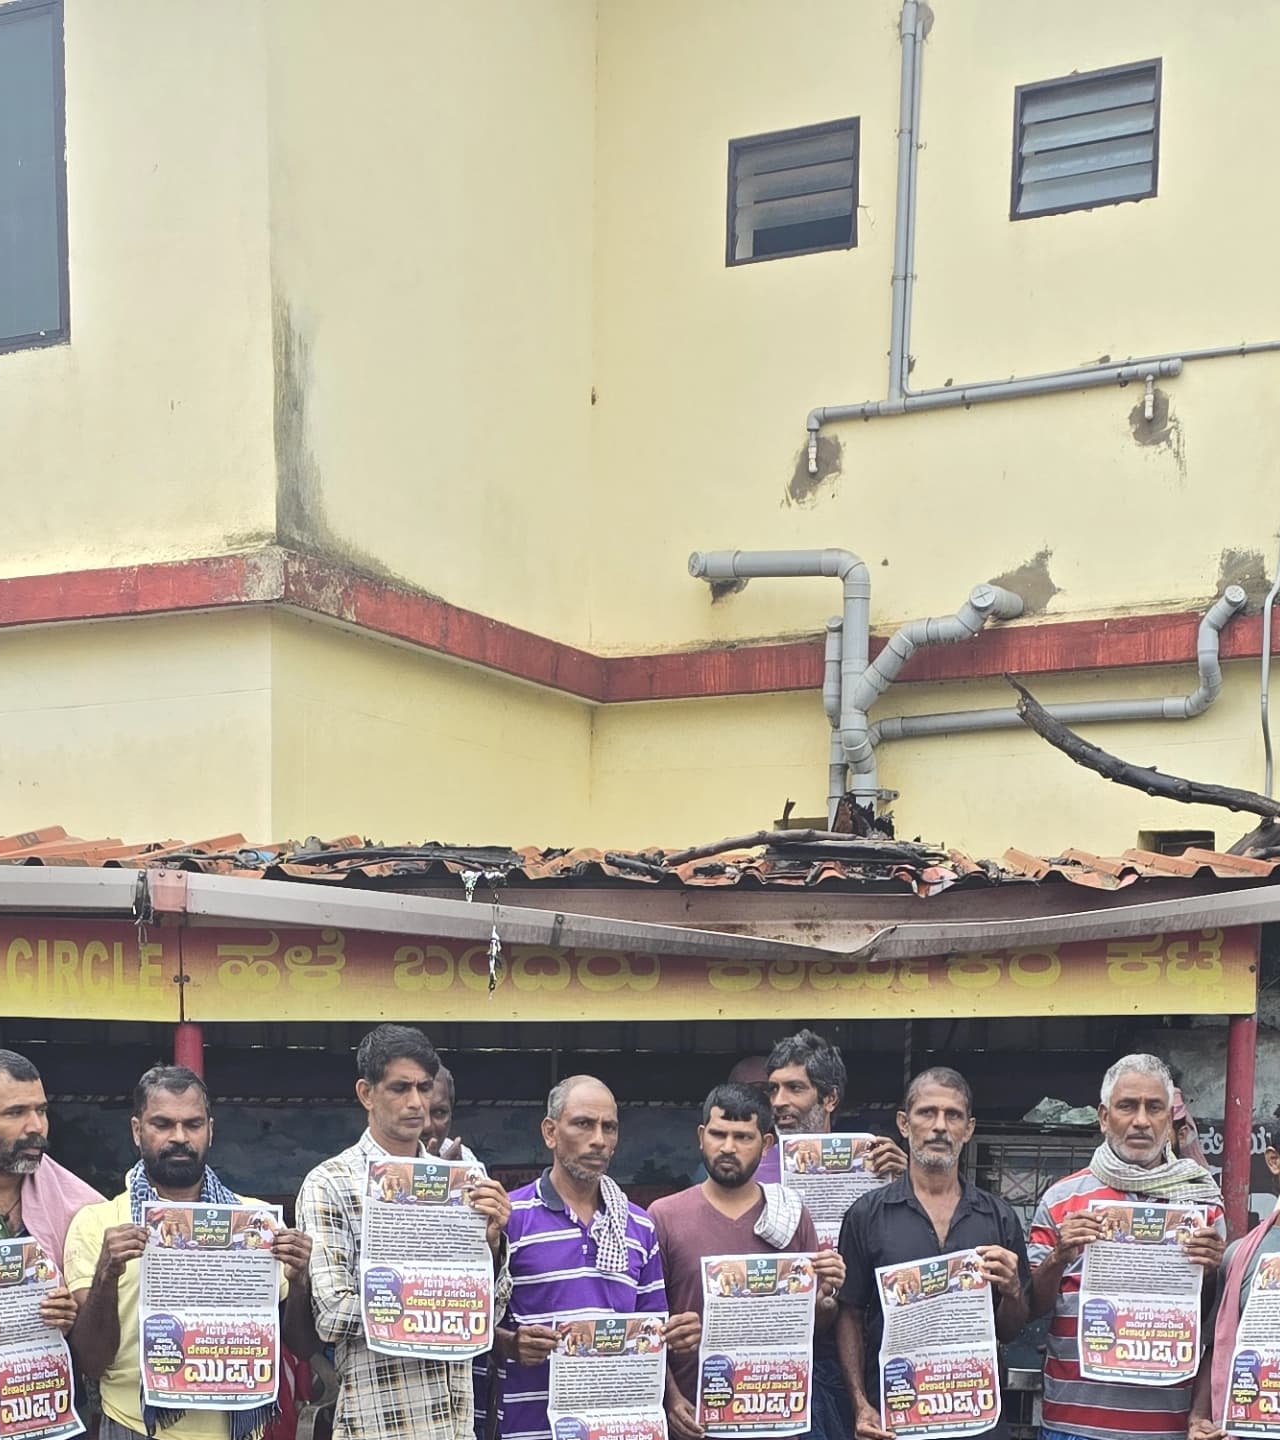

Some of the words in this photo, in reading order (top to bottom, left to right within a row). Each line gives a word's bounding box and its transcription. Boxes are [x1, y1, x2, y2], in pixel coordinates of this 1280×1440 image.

[6, 938, 164, 996] CIRCLE
[217, 929, 347, 992] ಹಳೆ
[403, 1310, 486, 1340] ಮುಷ್ಕರ
[1116, 1339, 1193, 1367] ಮುಷ್ಕರ
[184, 1359, 272, 1388] ಮುಷ್ಕರ
[1, 1390, 69, 1424] ಮುಷ್ಕರ
[732, 1392, 805, 1417] ಮುಷ್ಕರ
[917, 1390, 993, 1416] ಮುಷ್ಕರ
